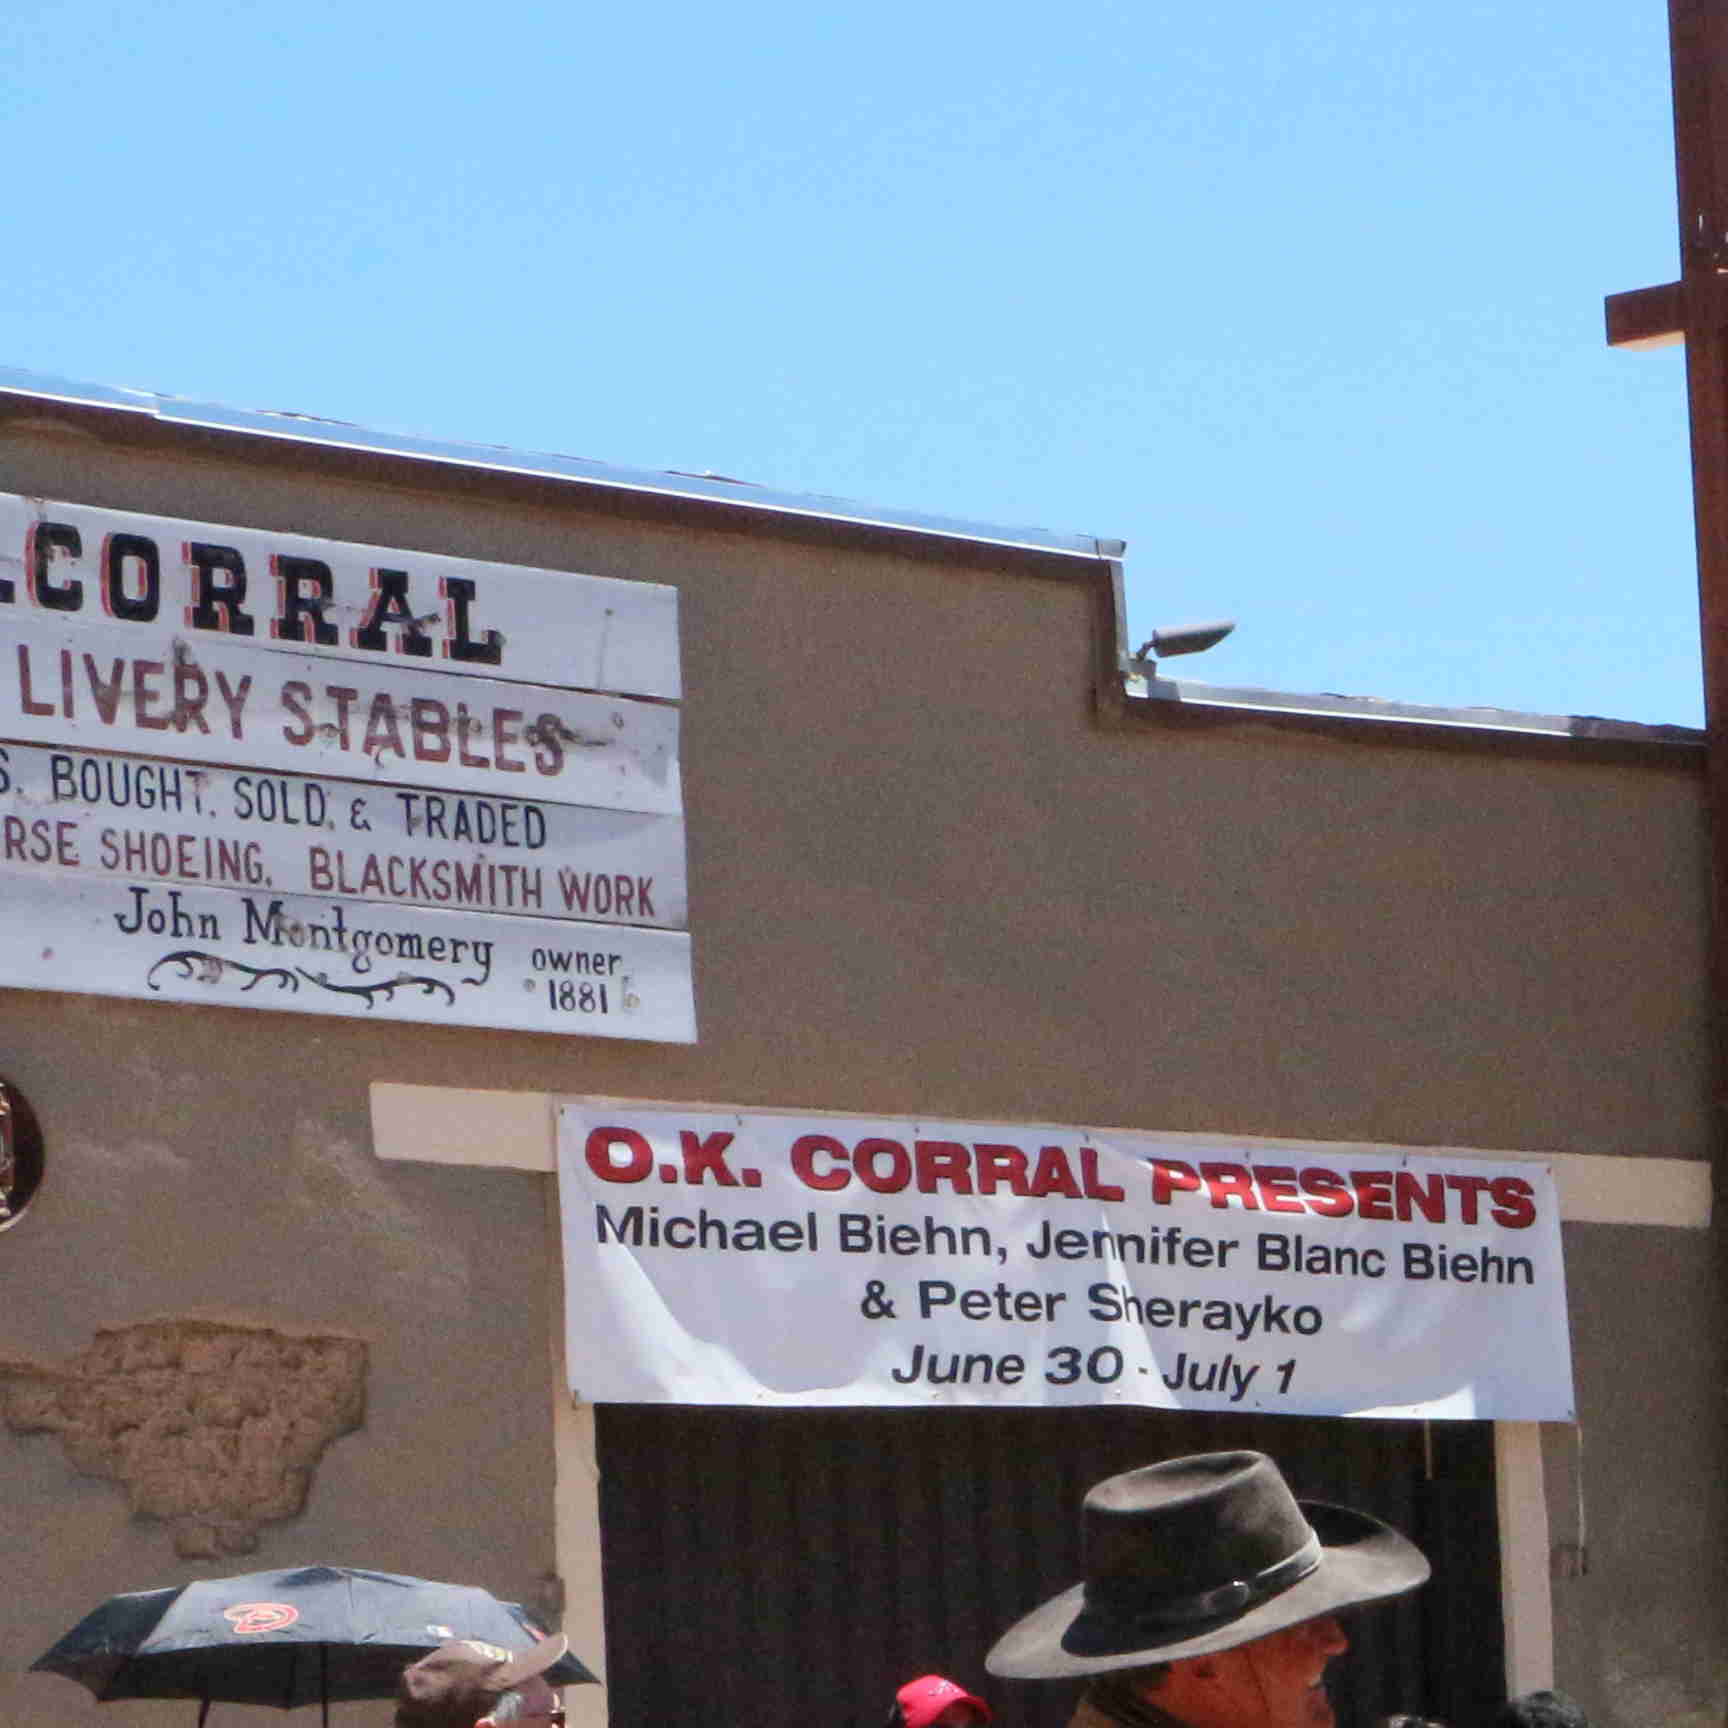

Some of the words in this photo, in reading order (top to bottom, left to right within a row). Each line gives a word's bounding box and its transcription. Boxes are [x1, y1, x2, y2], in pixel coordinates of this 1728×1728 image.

[24, 520, 502, 665] CORRAL
[17, 643, 252, 740] LIVERY
[280, 680, 565, 777] STABLES
[350, 798, 372, 832] &
[396, 792, 548, 850] TRADED
[308, 846, 543, 909] BLACKSMITH
[557, 869, 656, 917] WORK
[114, 885, 222, 941] John
[241, 897, 495, 987] Montgomery
[531, 947, 622, 977] owner
[548, 979, 608, 1014] 1881
[584, 1125, 763, 1188] O.K.
[789, 1133, 1126, 1203] CORRAL
[1146, 1156, 1538, 1230] PRESENTS
[594, 1203, 819, 1253] Michael
[838, 1212, 1008, 1265] Biehn,
[1026, 1219, 1240, 1270] Jennifer
[1256, 1232, 1387, 1279] Blanc
[1402, 1242, 1535, 1285] Biehn
[860, 1279, 897, 1320] &
[917, 1279, 1067, 1322] Peter
[1087, 1281, 1323, 1342] Sherayko
[891, 1344, 1026, 1385] June
[1043, 1345, 1125, 1386] 30
[1162, 1351, 1260, 1402] July
[1276, 1358, 1298, 1394] 1
